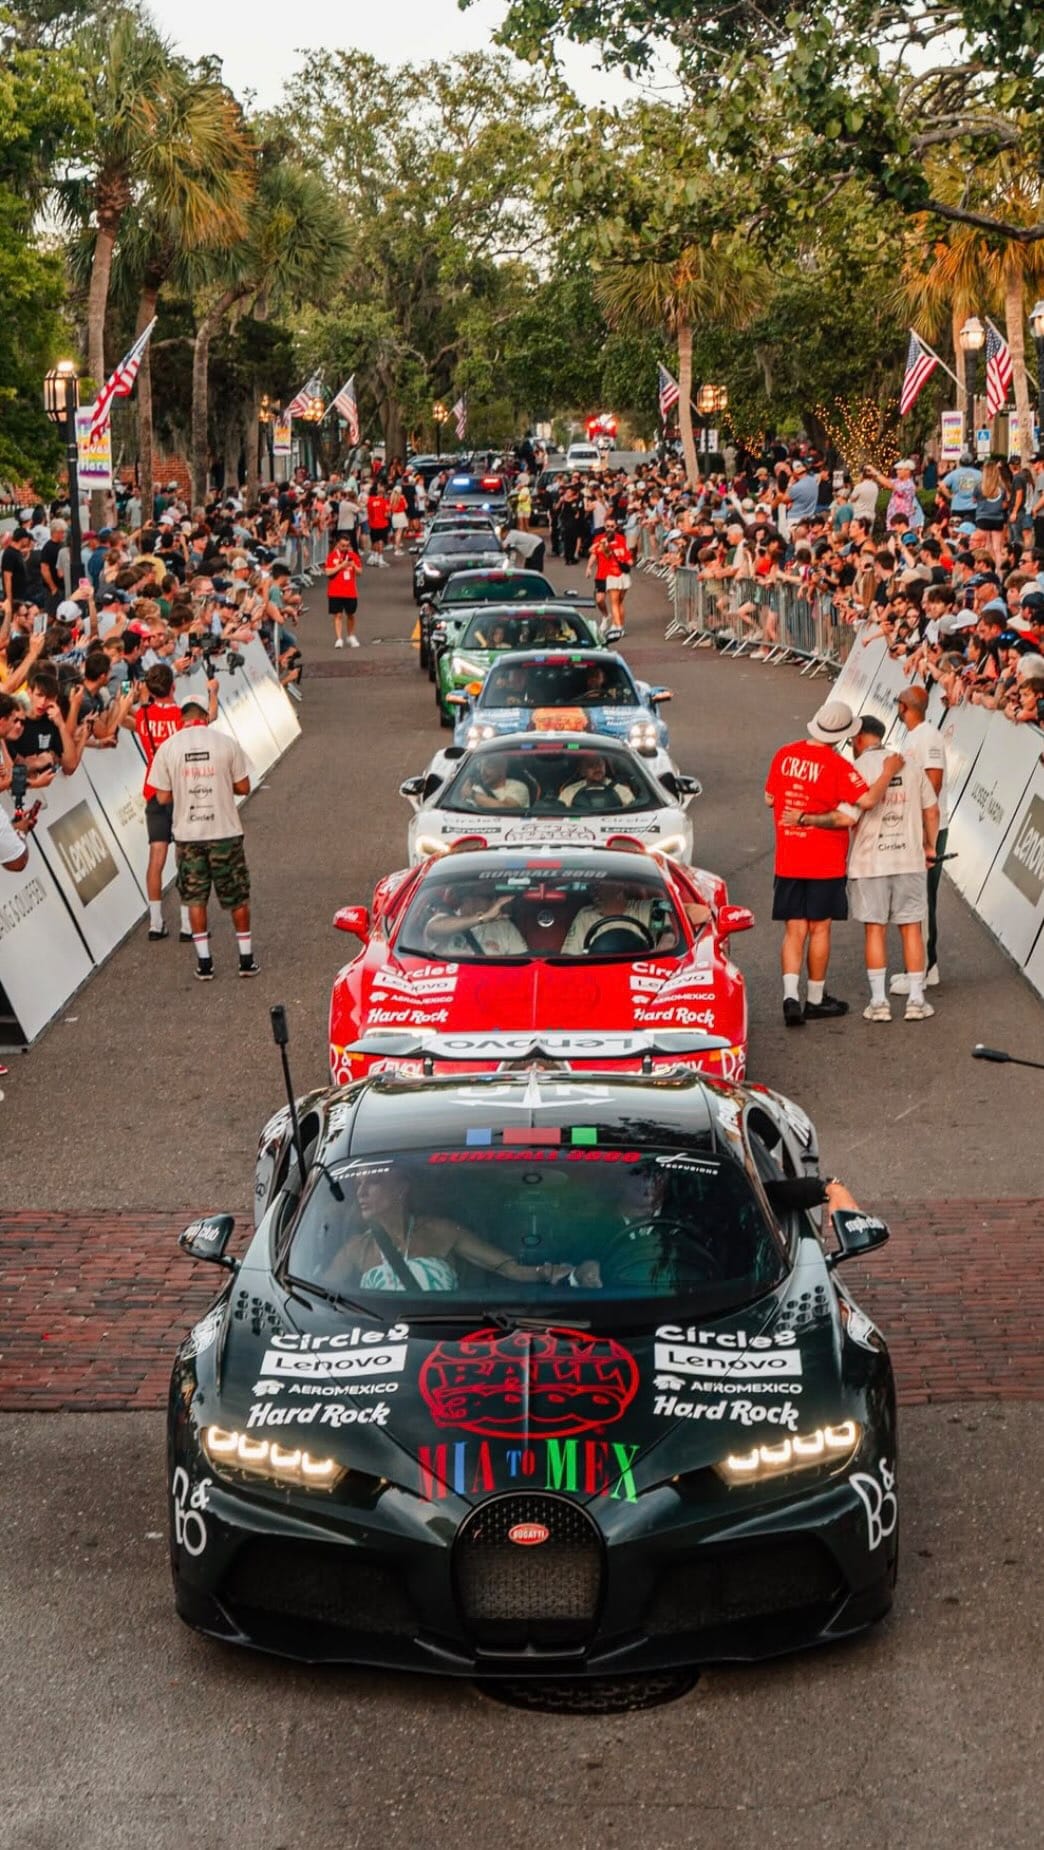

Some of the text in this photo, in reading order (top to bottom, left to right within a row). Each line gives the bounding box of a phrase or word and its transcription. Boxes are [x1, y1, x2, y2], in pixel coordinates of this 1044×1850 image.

[781, 756, 823, 783] CREW
[58, 828, 108, 883] Lenovo
[478, 869, 558, 879] GUMBALL
[367, 1007, 449, 1025] Hard Rock
[633, 1007, 715, 1029] Hard Rock
[427, 1150, 559, 1165] GUMBALL
[275, 1355, 393, 1372] Lenovo
[668, 1351, 788, 1370] Lenovo
[288, 1382, 400, 1397] AEROMEXICO
[691, 1381, 803, 1394] AEROMEXICO
[246, 1401, 392, 1428] Hard Rock
[653, 1395, 800, 1432] Hard Rock
[418, 1438, 641, 1505] MIA TO MEX
